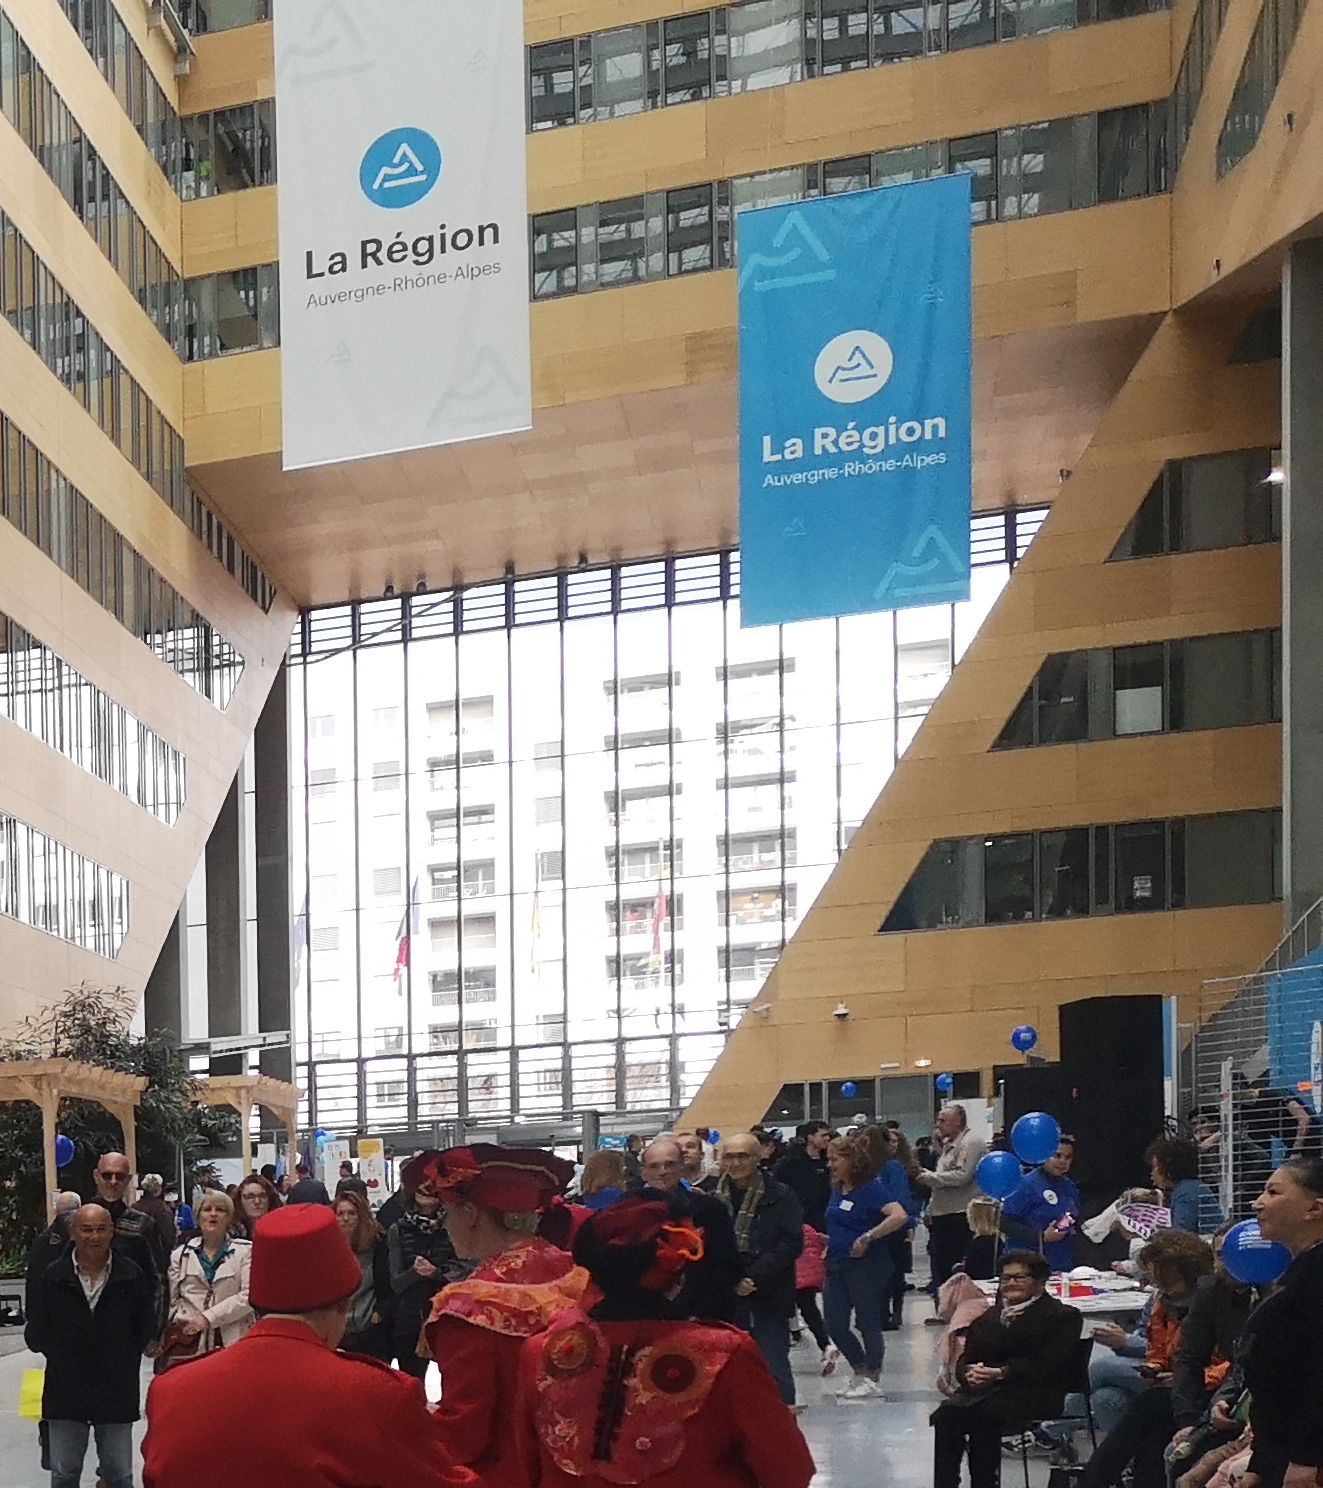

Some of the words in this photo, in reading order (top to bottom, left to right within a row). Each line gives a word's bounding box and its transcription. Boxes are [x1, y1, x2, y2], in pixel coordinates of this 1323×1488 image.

[305, 250, 348, 280] La
[360, 222, 500, 270] Région
[306, 261, 502, 310] Auvergne-Rhône-Alpes
[762, 434, 804, 463] La
[813, 415, 947, 456] Région
[762, 452, 947, 488] Auvergne-Rhône-Alpes
